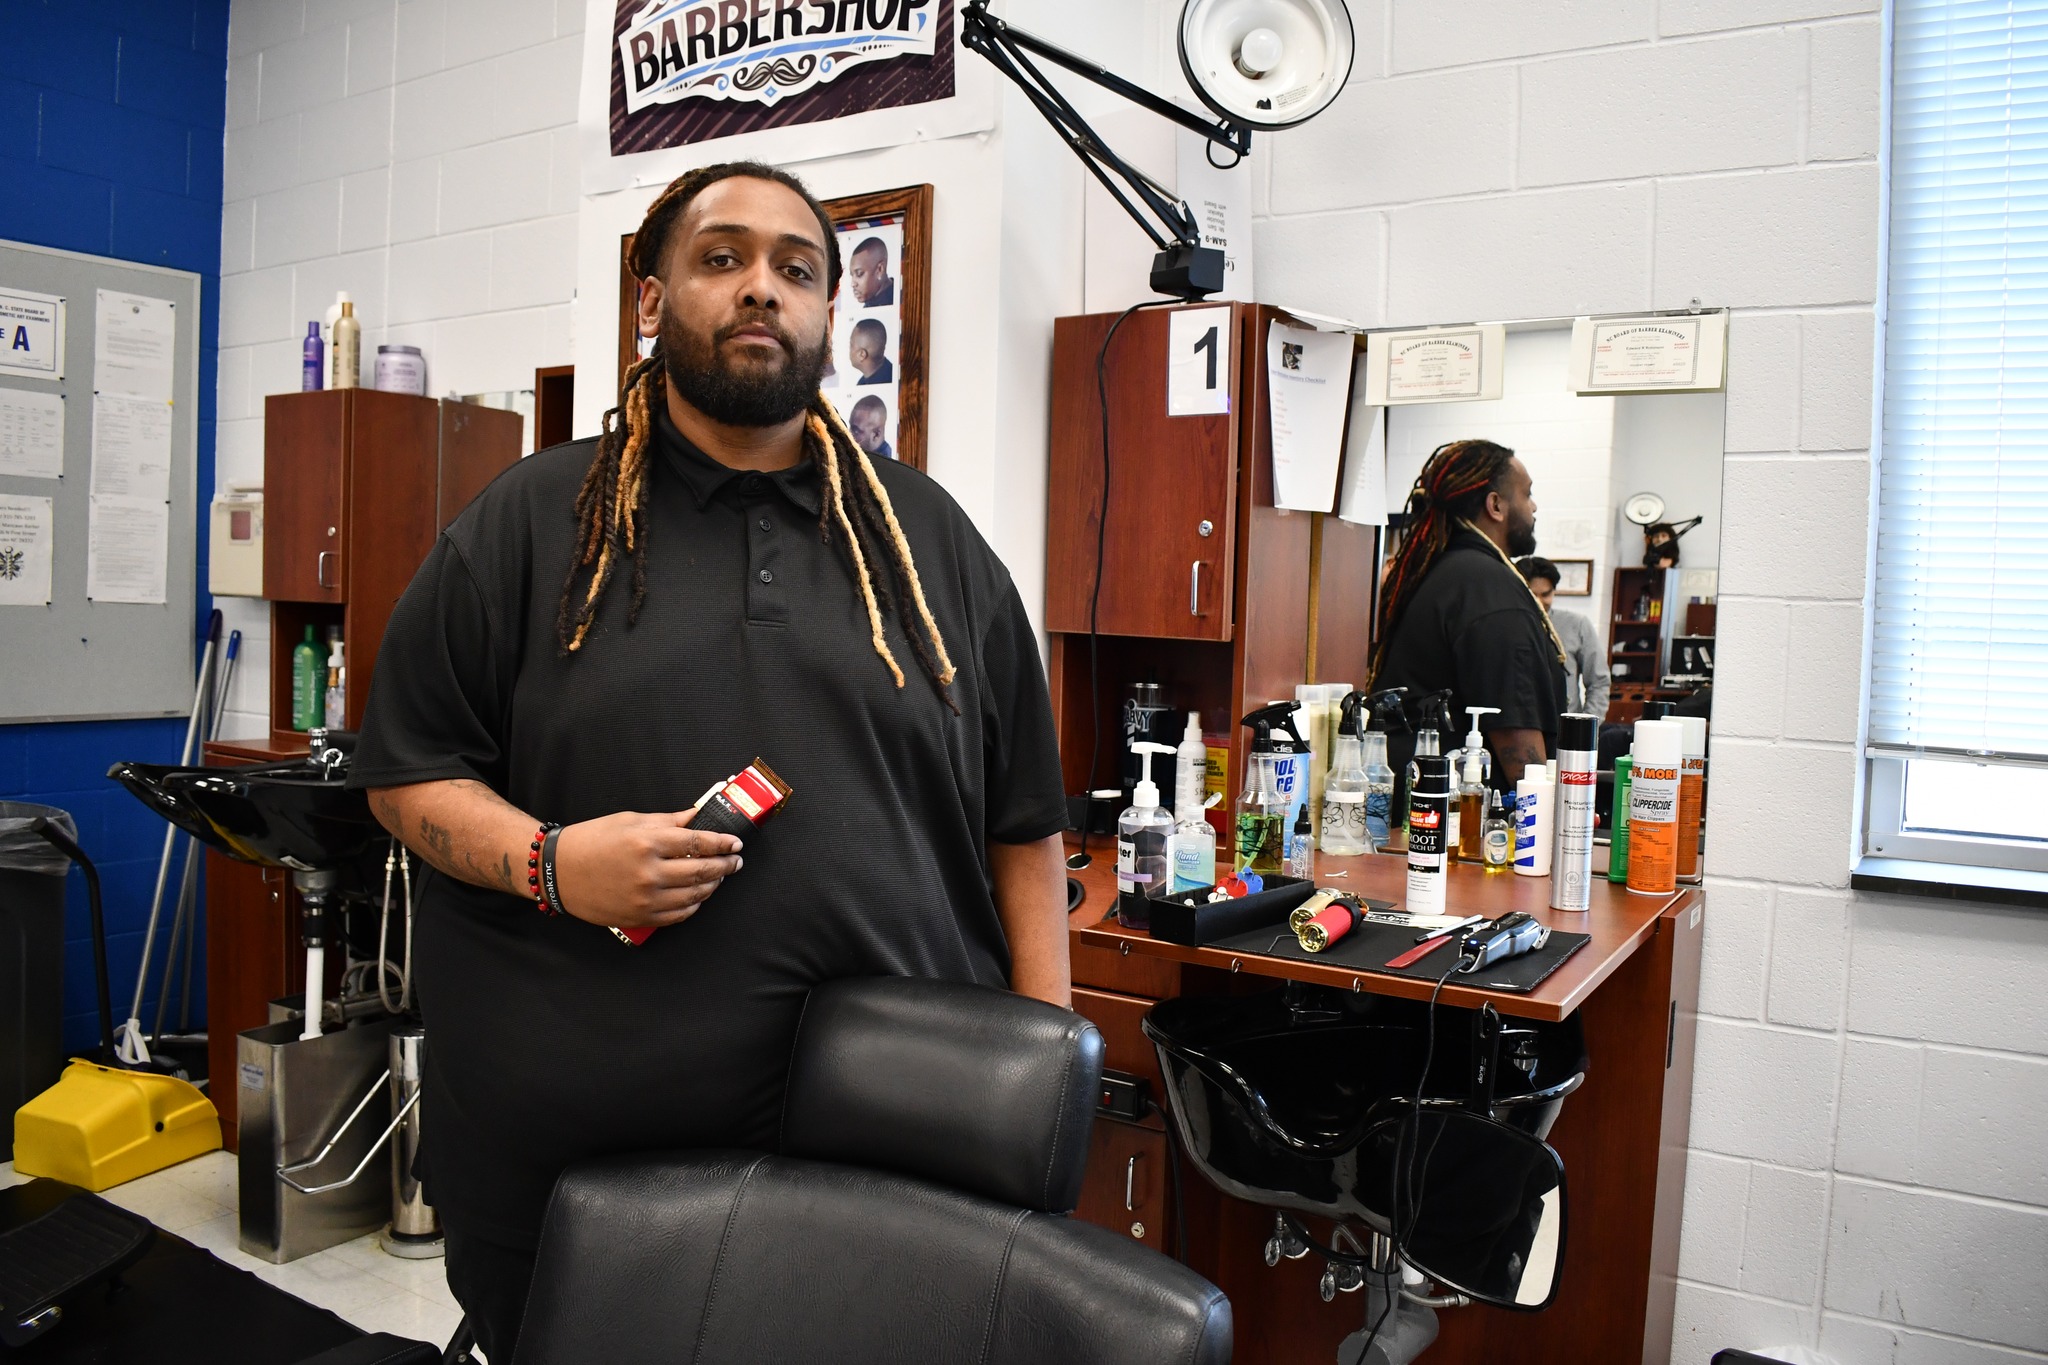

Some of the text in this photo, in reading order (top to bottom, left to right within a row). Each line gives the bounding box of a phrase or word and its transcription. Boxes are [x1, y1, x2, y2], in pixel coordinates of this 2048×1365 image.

[629, 0, 929, 94] BARBERSHOP
[1205, 235, 1228, 247] SAM-9
[26, 315, 50, 323] EXAMINERS
[12, 325, 31, 352] A
[1613, 329, 1630, 339] BOARD
[1659, 328, 1685, 340] EXAMINERS
[1406, 343, 1421, 352] BOARD
[1446, 340, 1470, 352] EXAMINERS
[1193, 326, 1218, 390] 1
[1643, 767, 1678, 780] MORE
[1632, 797, 1673, 811] CLIPPERCIDE
[1175, 849, 1201, 862] Hand
